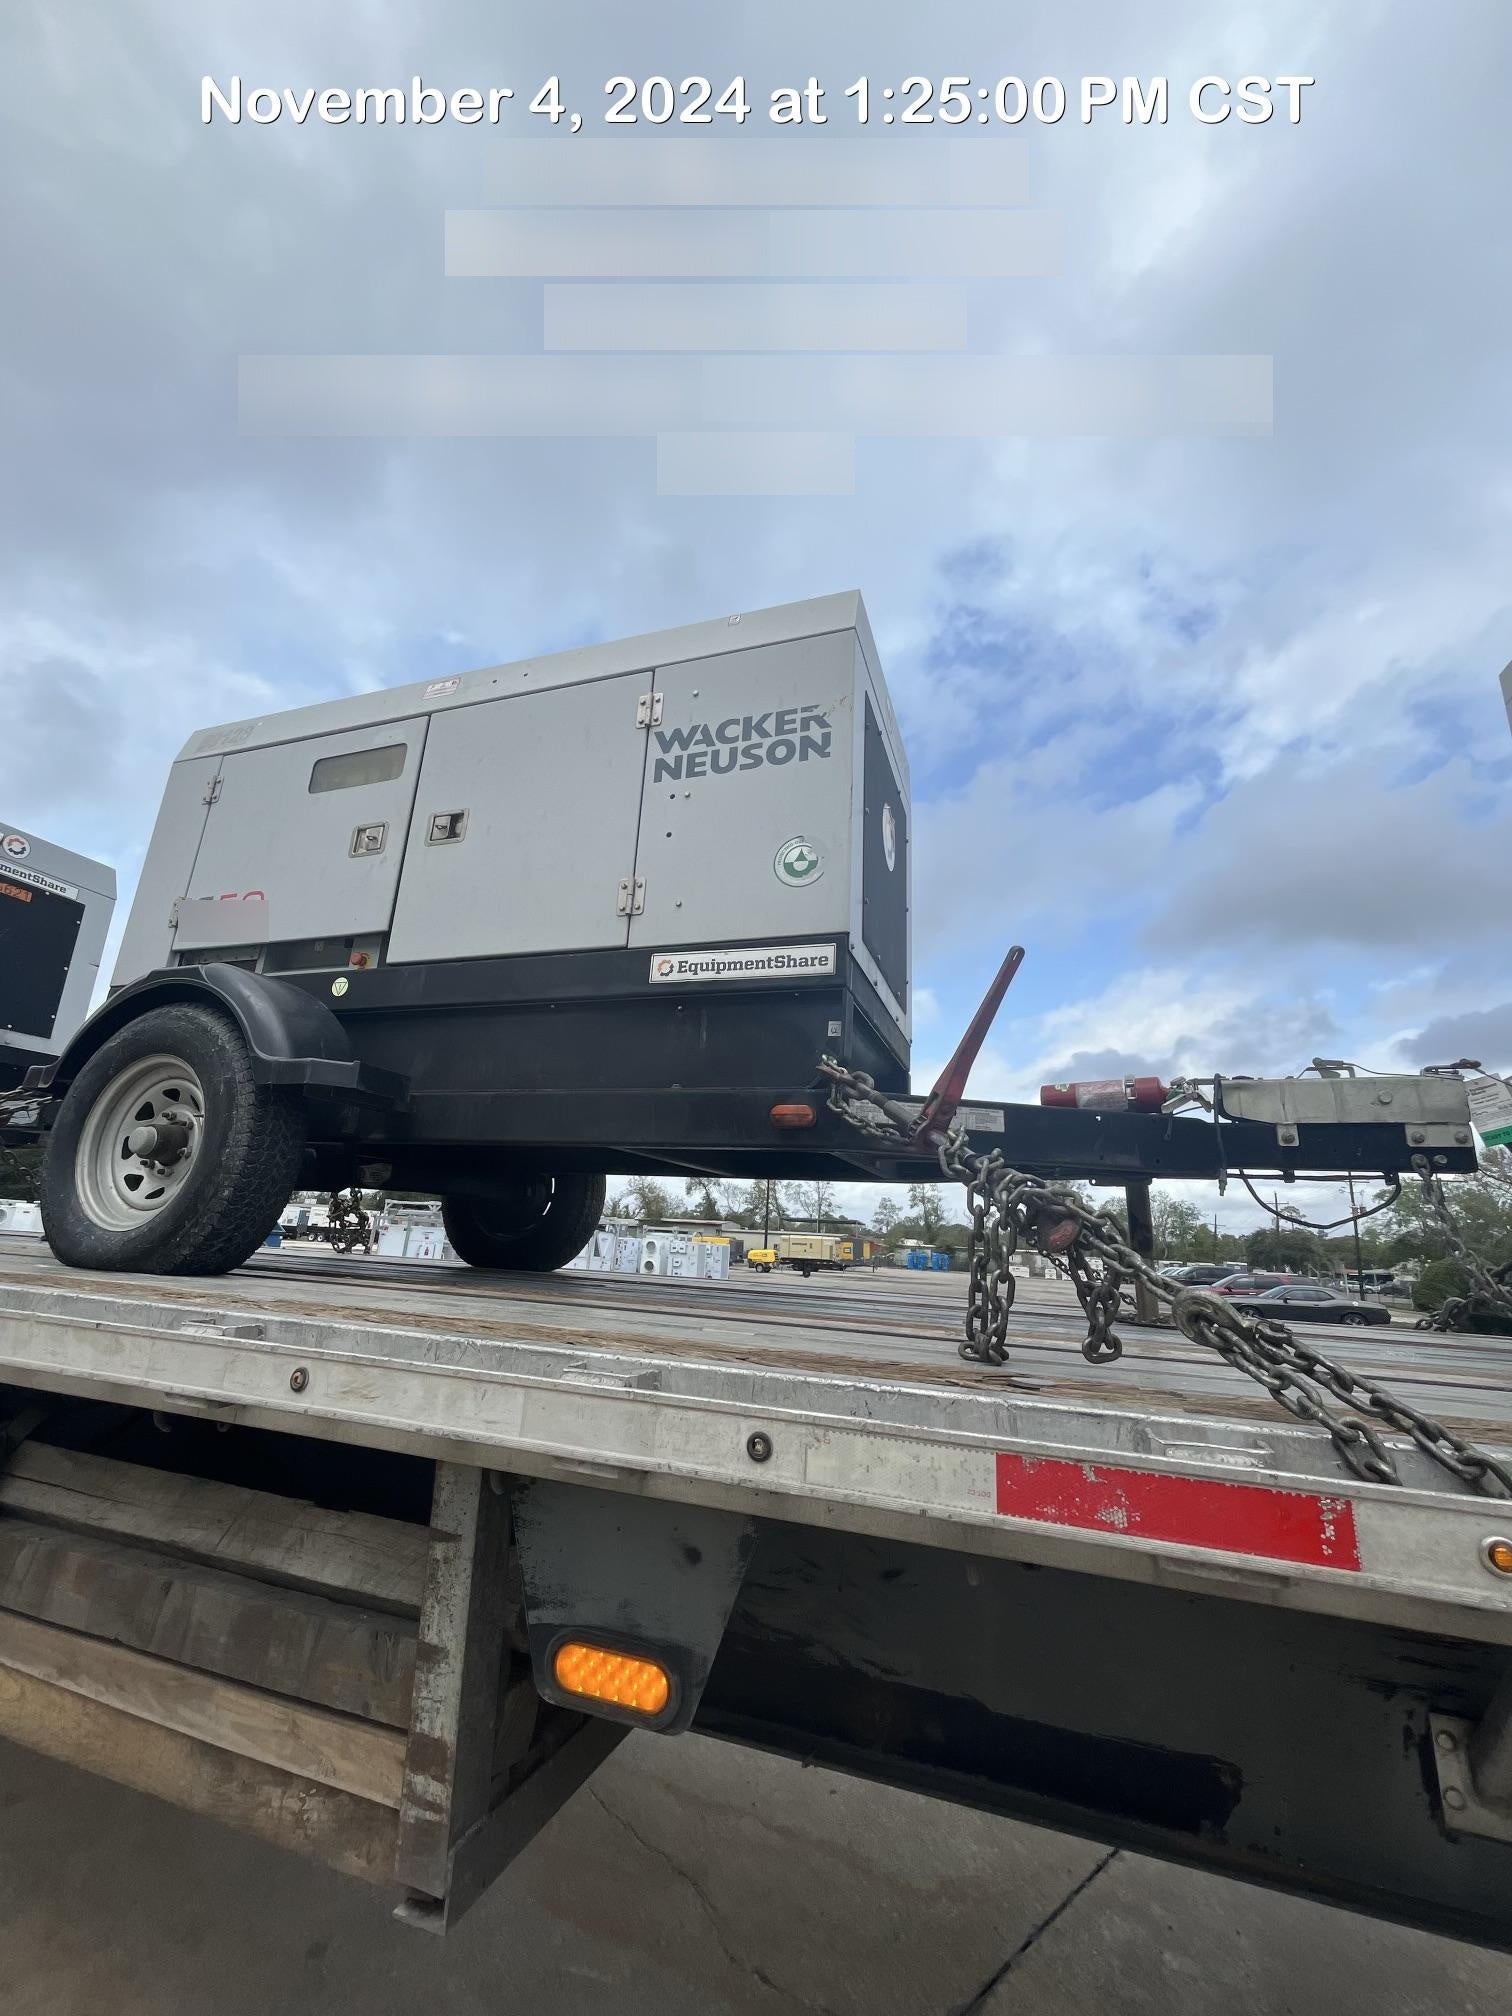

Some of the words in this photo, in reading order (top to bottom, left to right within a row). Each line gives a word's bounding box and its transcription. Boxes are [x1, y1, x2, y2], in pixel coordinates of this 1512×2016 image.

[654, 704, 832, 754] WACKER
[654, 731, 831, 783] NEUSON
[677, 955, 829, 975] EquipmentShare
